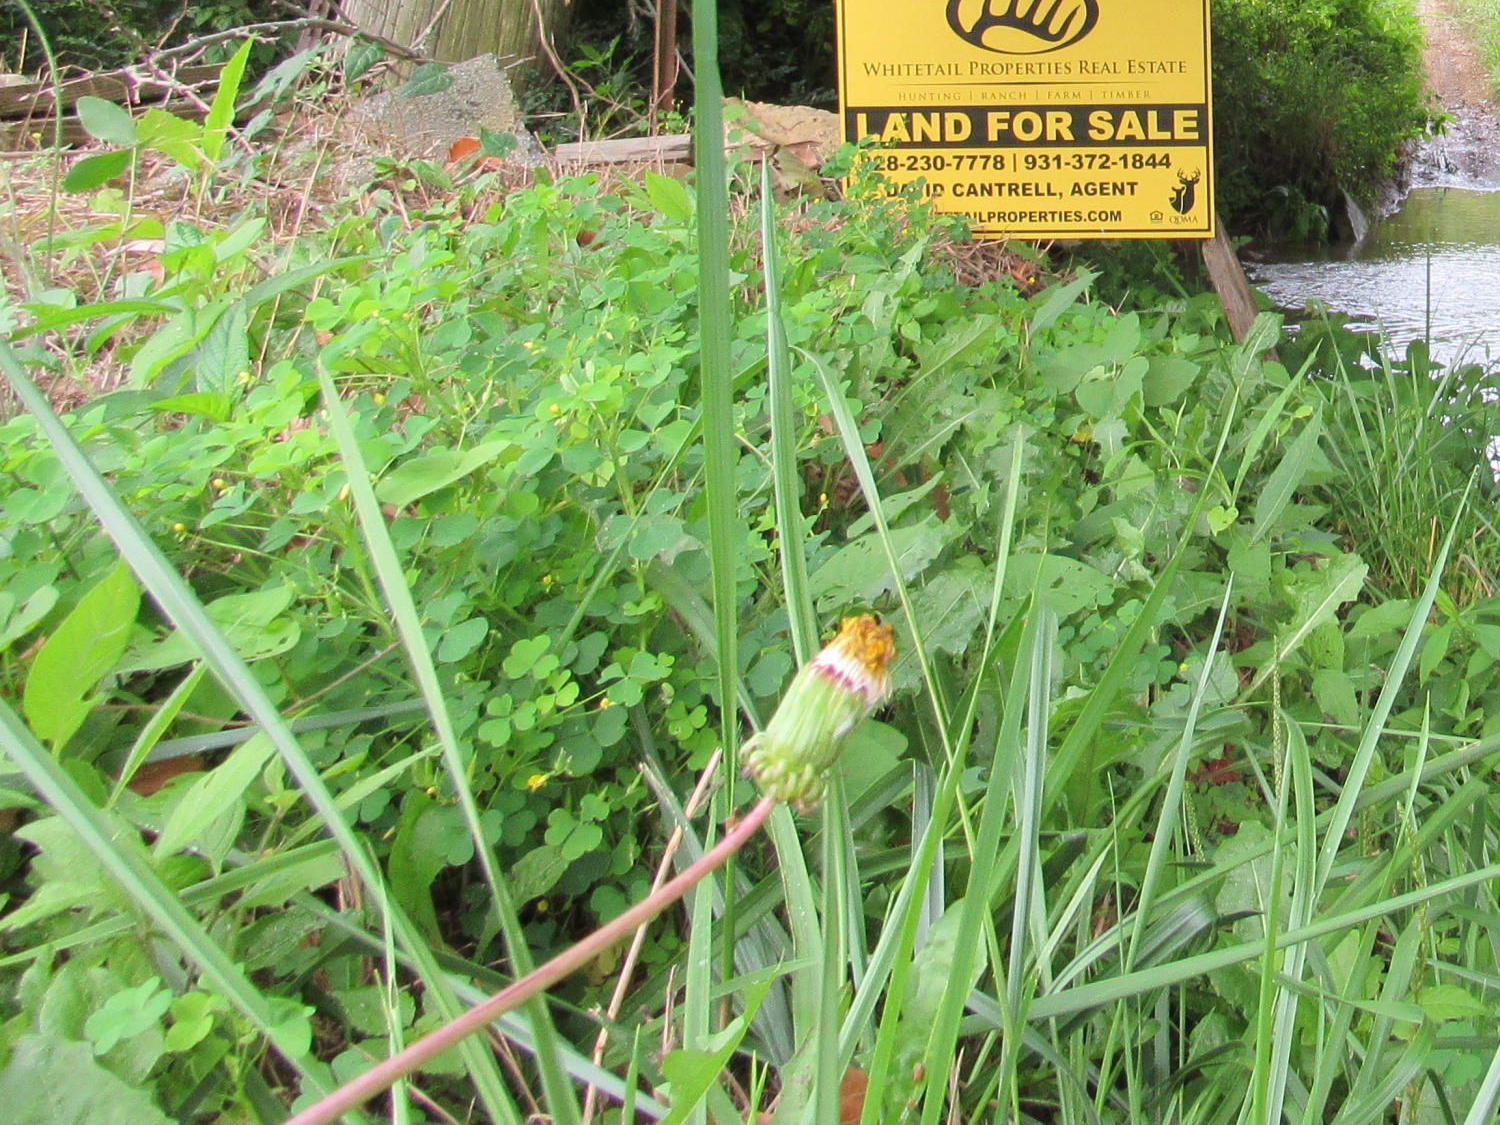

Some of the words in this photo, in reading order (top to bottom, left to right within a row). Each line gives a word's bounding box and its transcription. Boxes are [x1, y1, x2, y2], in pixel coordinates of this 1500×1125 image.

[863, 61, 963, 77] WHITETAIL
[969, 60, 1072, 76] PROPERTIES
[1078, 59, 1121, 75] REAL
[1127, 59, 1187, 75] ESTATE
[898, 91, 961, 101] HUNTING
[980, 90, 1027, 100] RANCH
[1047, 90, 1082, 100] FARM
[1100, 90, 1151, 100] TIMBER
[856, 112, 972, 142] LAND
[986, 111, 1075, 141] FOR
[1088, 109, 1200, 140] SALE
[862, 154, 1005, 171] 28-230-7778
[1024, 153, 1172, 170] 931-372-1844
[952, 182, 1064, 198] CANTRELL,
[1070, 181, 1138, 196] AGENT
